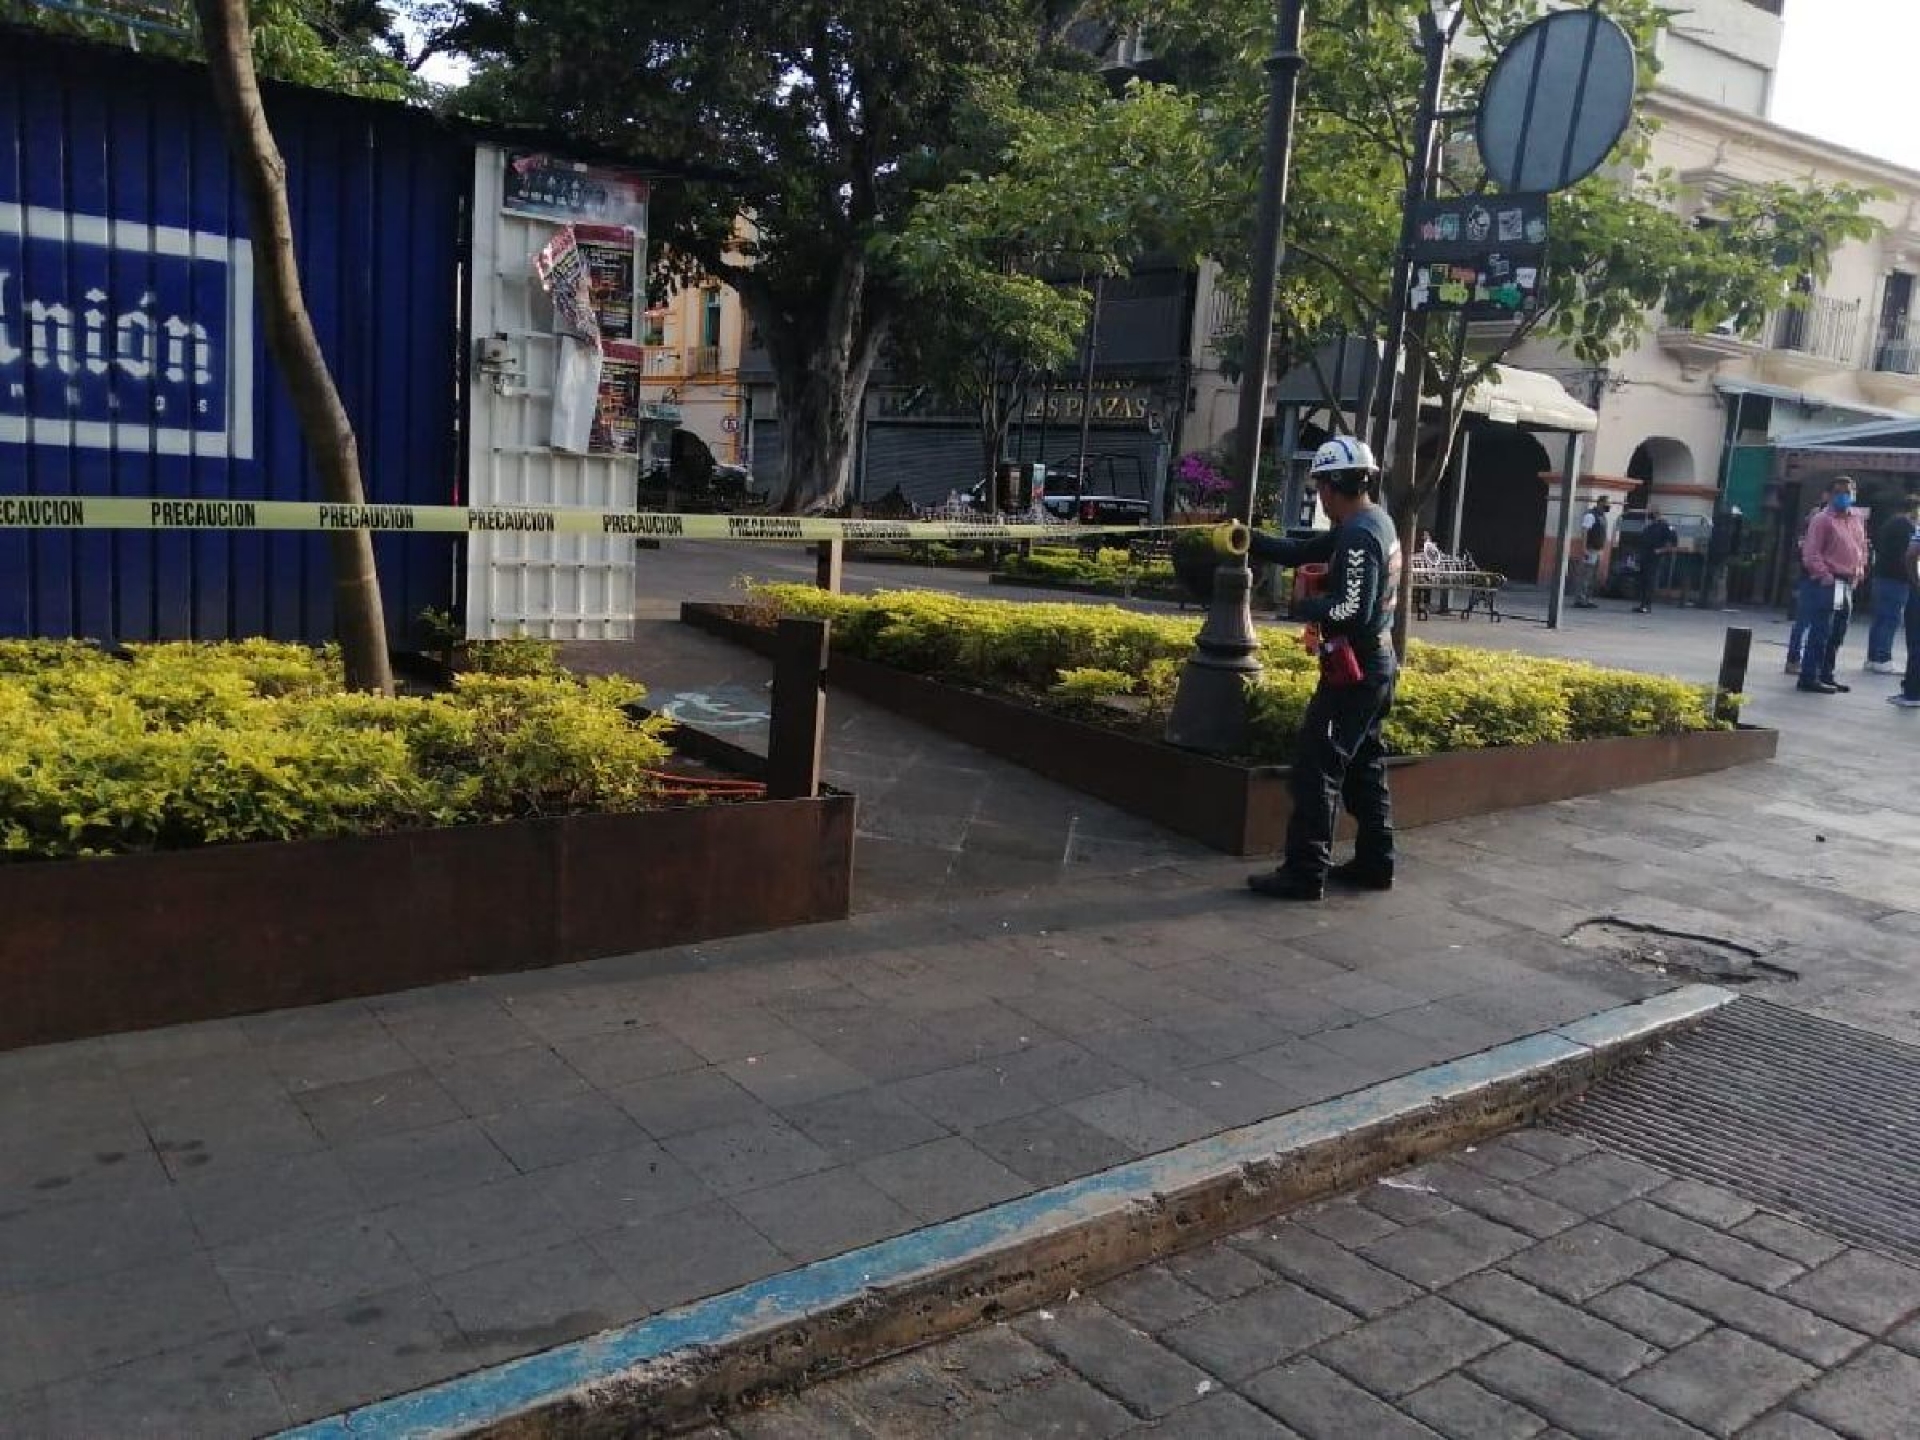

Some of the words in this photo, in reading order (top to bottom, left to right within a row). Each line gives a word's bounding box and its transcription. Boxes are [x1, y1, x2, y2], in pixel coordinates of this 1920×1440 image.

[151, 501, 256, 527] PRECAUCION
[319, 505, 414, 529] PRECAUCION
[468, 508, 555, 532] PRECAUCION
[602, 514, 682, 535] PRECAUCION
